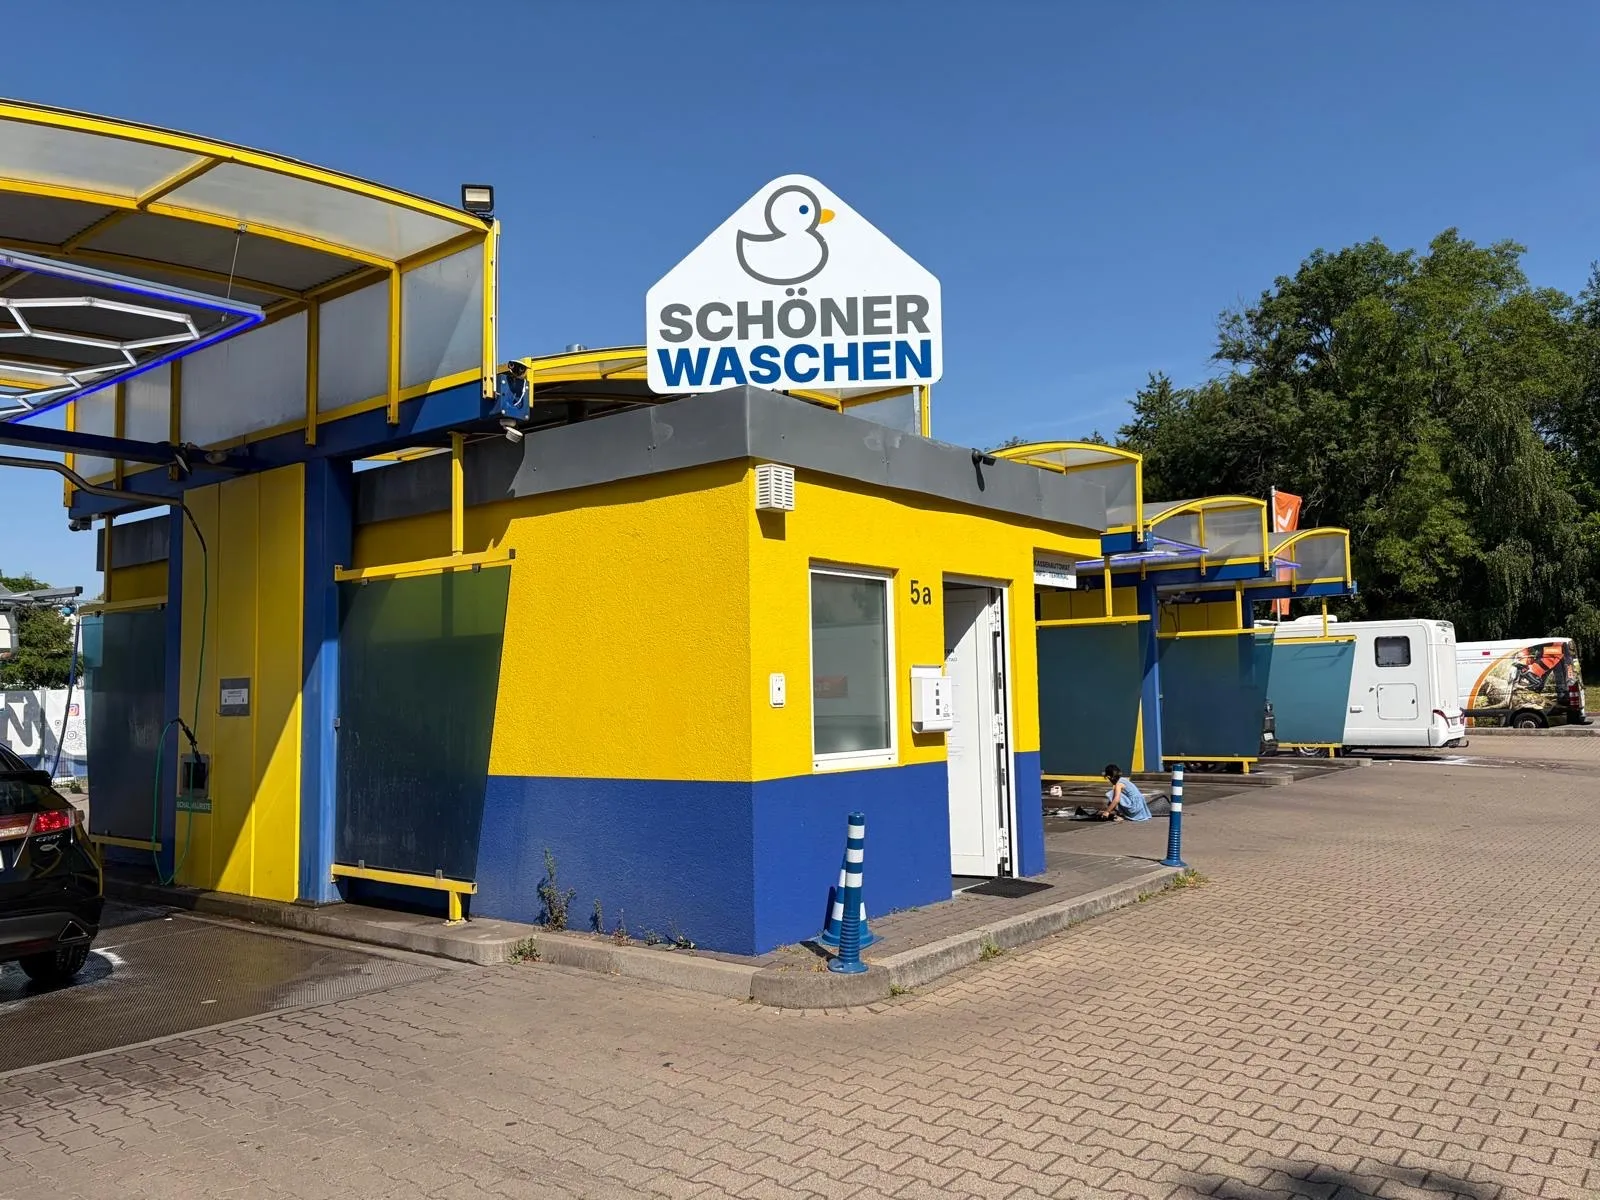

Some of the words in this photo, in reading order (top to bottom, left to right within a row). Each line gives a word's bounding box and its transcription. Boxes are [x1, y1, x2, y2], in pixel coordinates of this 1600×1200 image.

[659, 287, 931, 343] SCHÖNER
[656, 339, 932, 387] WASCHEN
[910, 579, 931, 606] 5a
